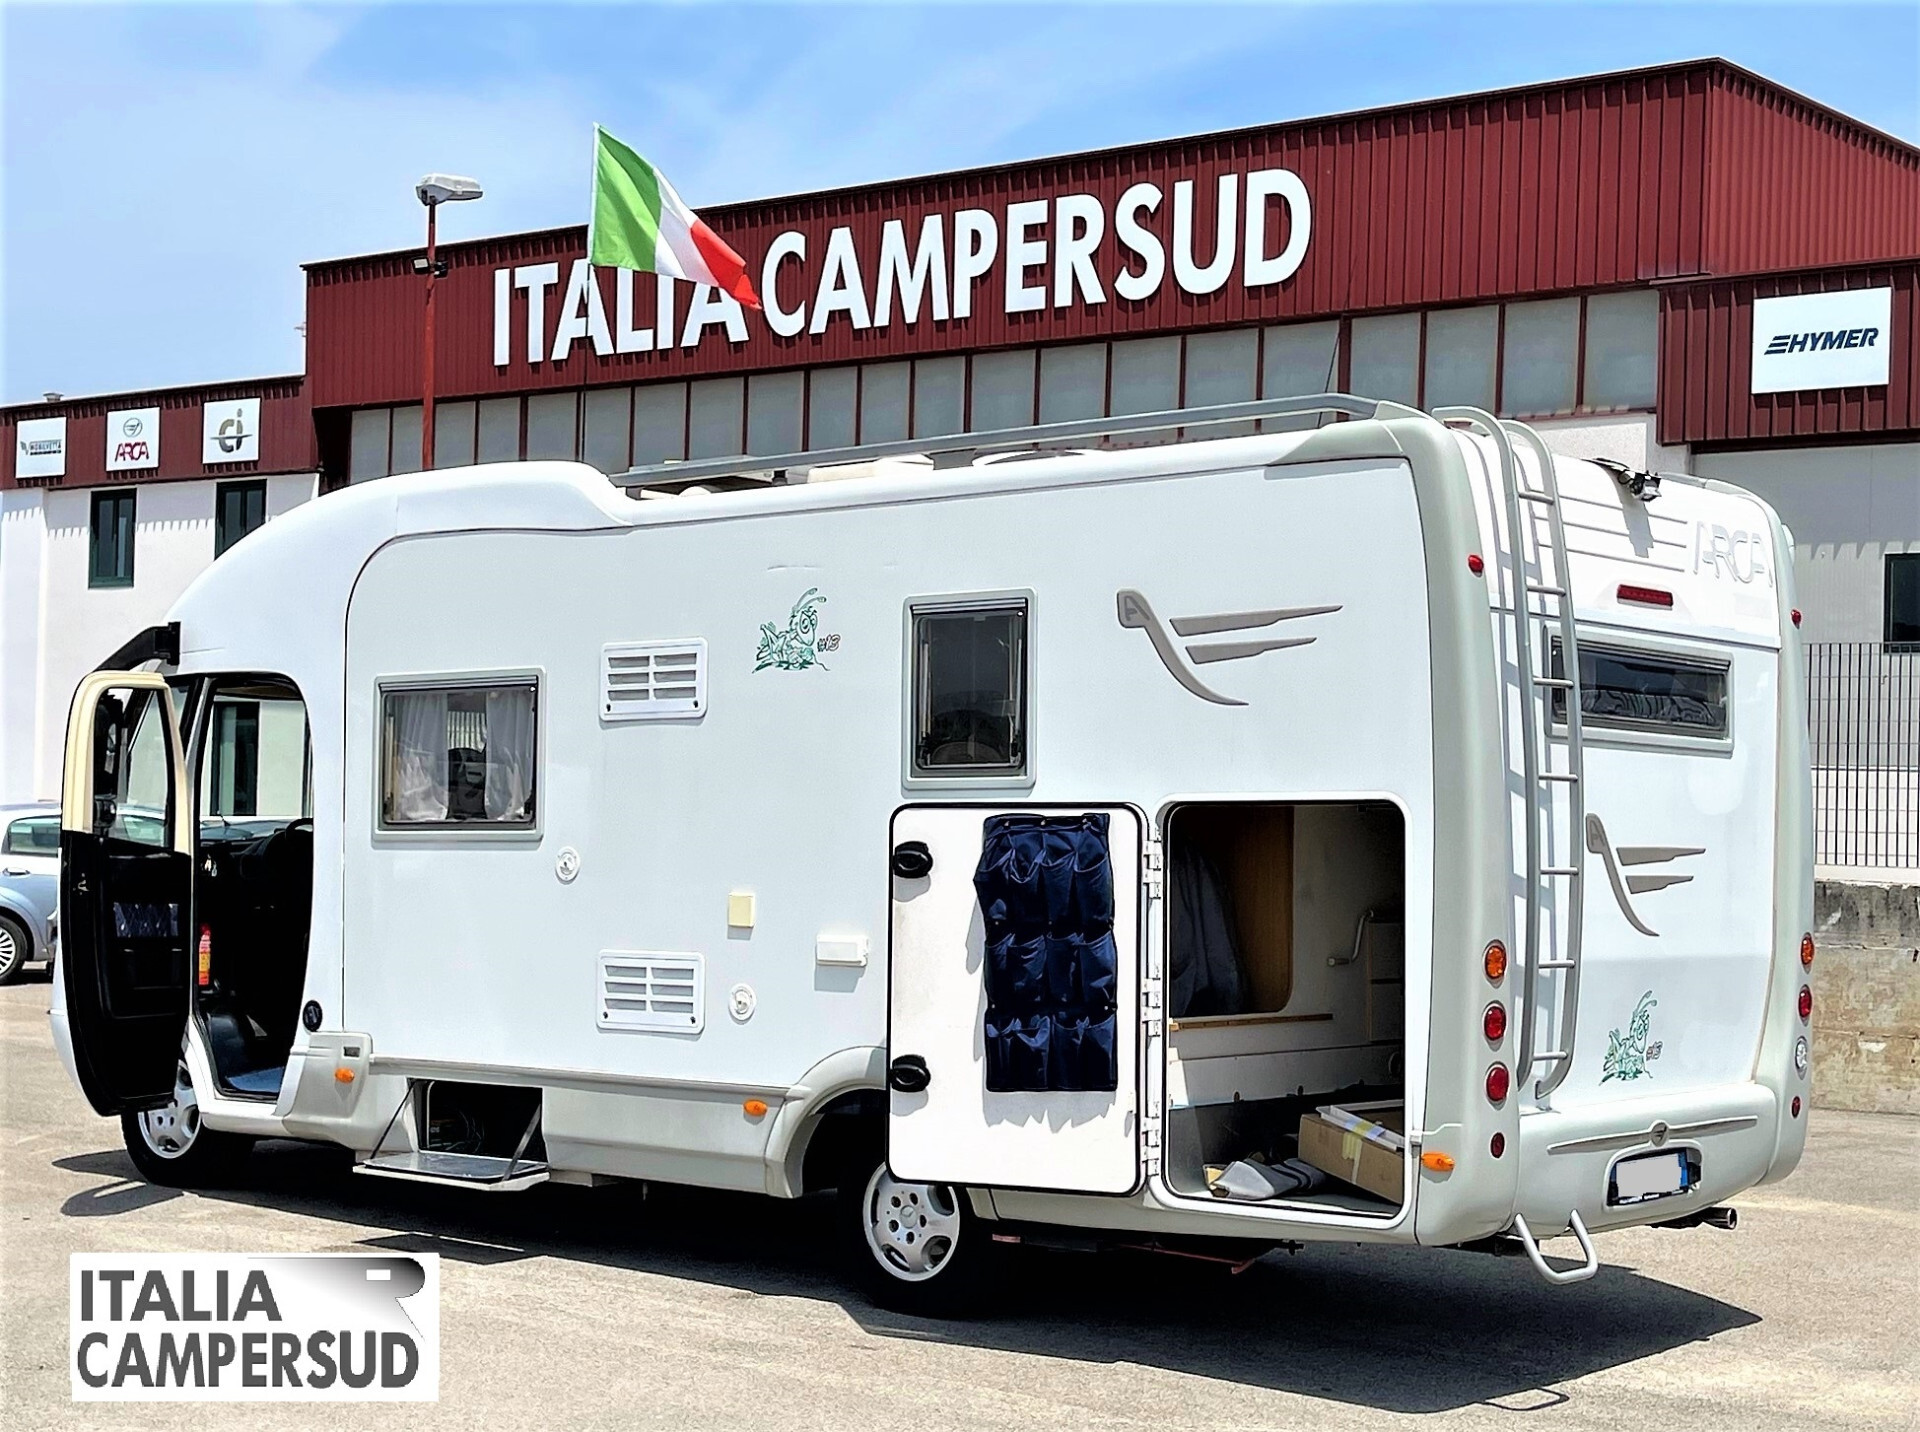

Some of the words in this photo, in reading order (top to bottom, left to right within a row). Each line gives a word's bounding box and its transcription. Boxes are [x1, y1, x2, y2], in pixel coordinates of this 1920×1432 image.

[493, 259, 748, 366] ITALIA
[762, 168, 1312, 338] CAMPERSUD
[1787, 327, 1879, 354] HYMER
[114, 441, 150, 462] ARCA
[1693, 521, 1774, 589] ARCA
